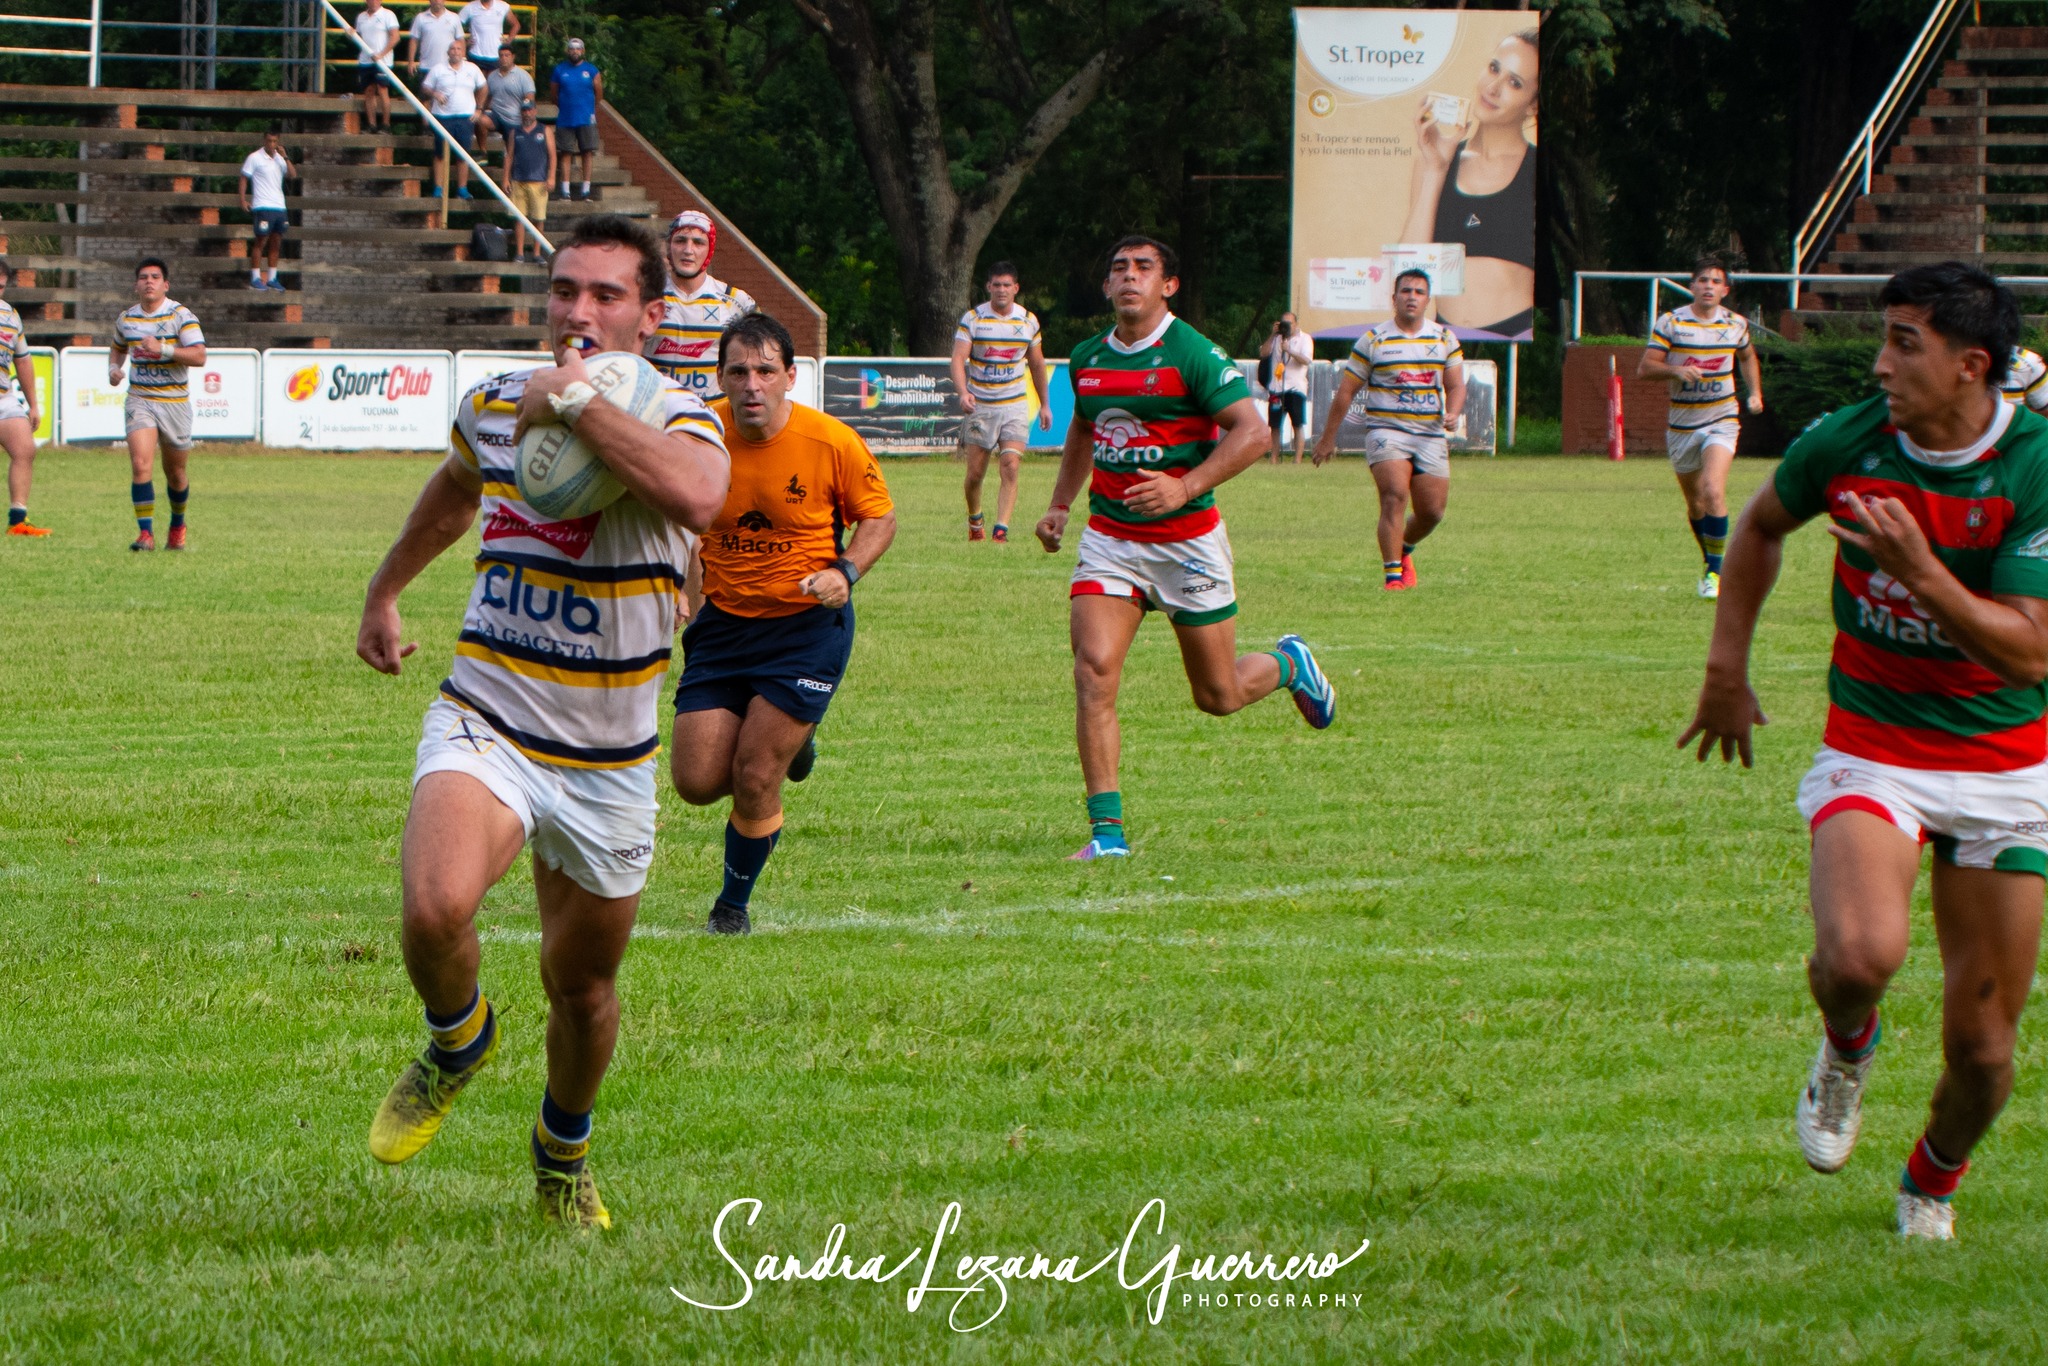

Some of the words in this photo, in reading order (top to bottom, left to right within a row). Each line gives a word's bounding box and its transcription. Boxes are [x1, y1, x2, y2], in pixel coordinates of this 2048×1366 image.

[1356, 45, 1425, 68] Tropez
[1315, 132, 1349, 145] Tropez
[1352, 136, 1361, 144] se
[1365, 133, 1401, 144] renovó
[1308, 147, 1320, 157] yo
[1323, 145, 1332, 156] lo
[1335, 146, 1366, 156] siento
[1368, 147, 1380, 156] en
[1383, 147, 1392, 156] la
[1394, 147, 1412, 156] Piel
[1344, 277, 1367, 287] Tropez
[328, 363, 433, 401] SportClub
[885, 373, 936, 389] Desarrollos
[91, 388, 128, 406] Terra
[196, 399, 230, 408] SIGMA
[885, 389, 945, 405] Inmobiliarios
[197, 409, 229, 418] AGRO
[476, 432, 513, 446] PROCE
[1093, 439, 1163, 464] Macro
[785, 497, 804, 505] URT
[721, 533, 793, 554] Macro
[1182, 581, 1217, 595] PROCER
[477, 563, 604, 638] club
[1856, 595, 1951, 648] Mac
[502, 627, 598, 660] GACETA
[797, 678, 833, 693] PROCER
